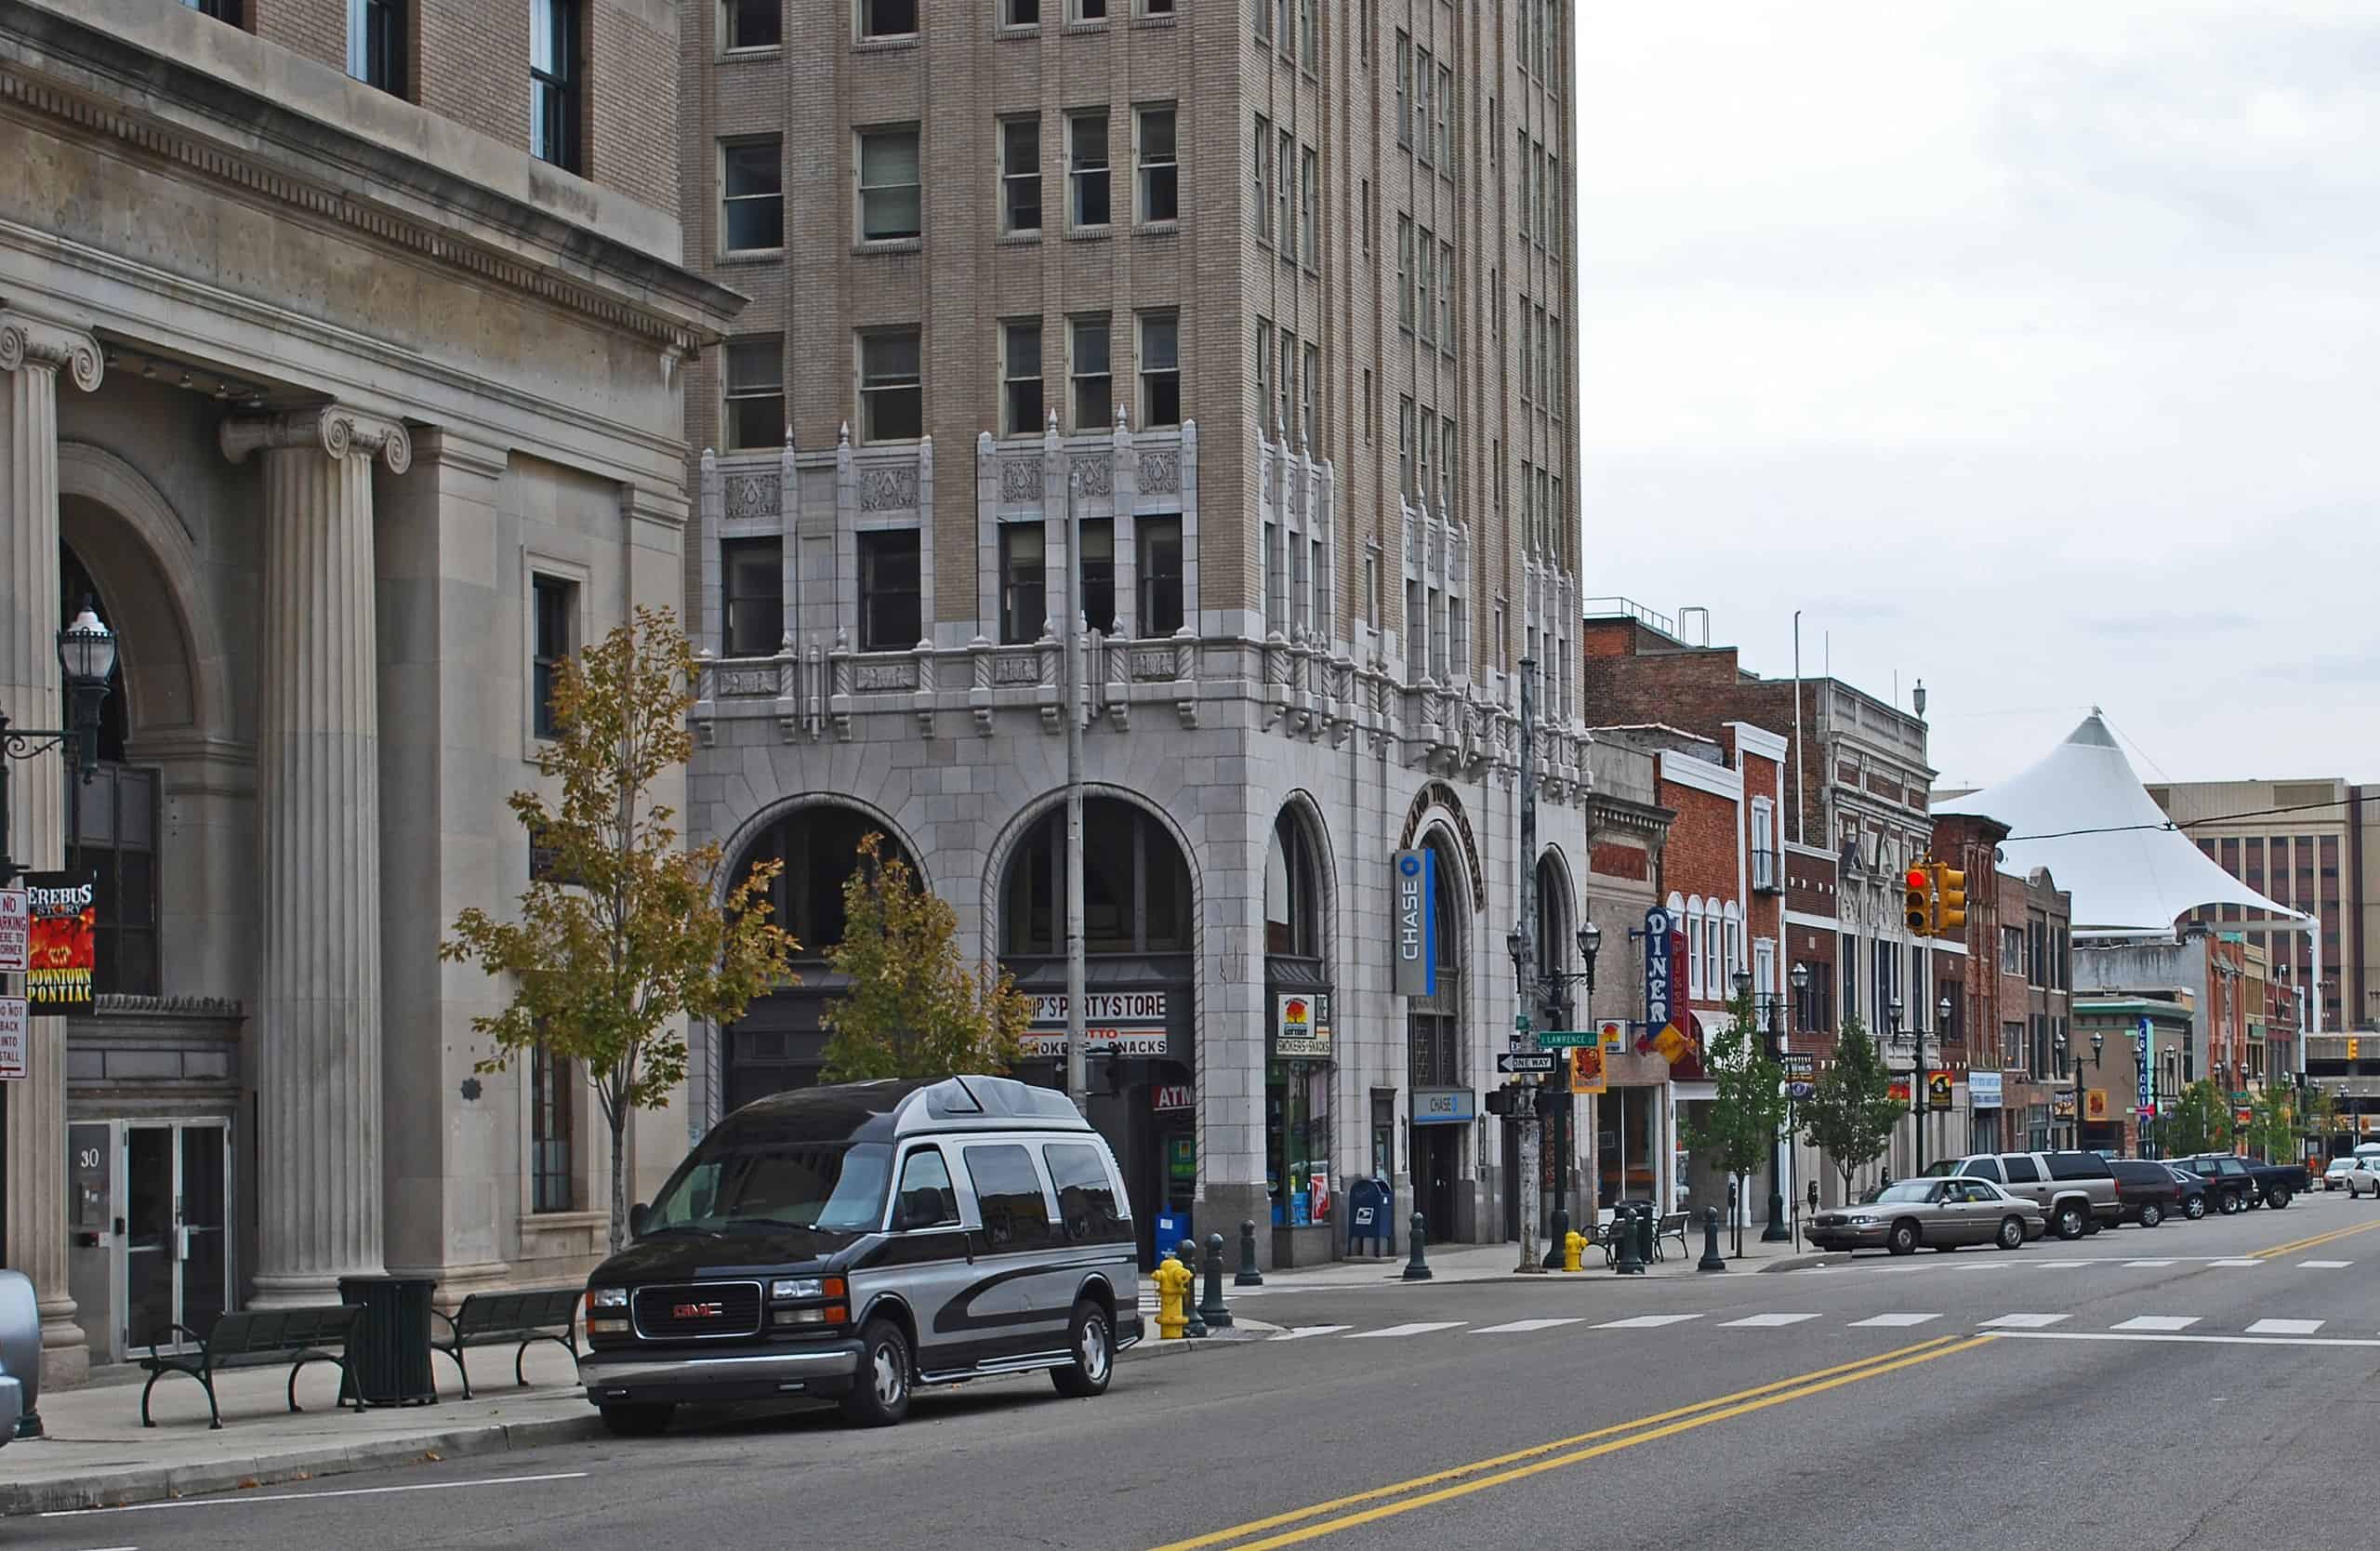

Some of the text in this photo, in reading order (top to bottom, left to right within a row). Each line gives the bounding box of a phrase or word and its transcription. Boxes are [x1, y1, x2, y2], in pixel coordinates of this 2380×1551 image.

[26, 883, 93, 906] EREBUS
[3, 895, 17, 912] NO
[0, 915, 26, 932] ARKING
[1403, 881, 1418, 960] CHASE
[0, 933, 16, 943] ERE
[0, 944, 22, 955] ORNER
[27, 967, 91, 986] DOWNTOWN
[1647, 913, 1667, 1023] DINER
[27, 985, 91, 1002] PONTIAC
[9, 1006, 22, 1017] NOT
[1059, 996, 1108, 1017] PRTY
[1113, 995, 1166, 1016] STORE
[1, 1036, 18, 1047] INTO
[1547, 1035, 1585, 1044] LAWRENCE
[1513, 1058, 1549, 1068] ONE WAY
[81, 1147, 99, 1168] 30
[673, 1303, 721, 1318] GMC
